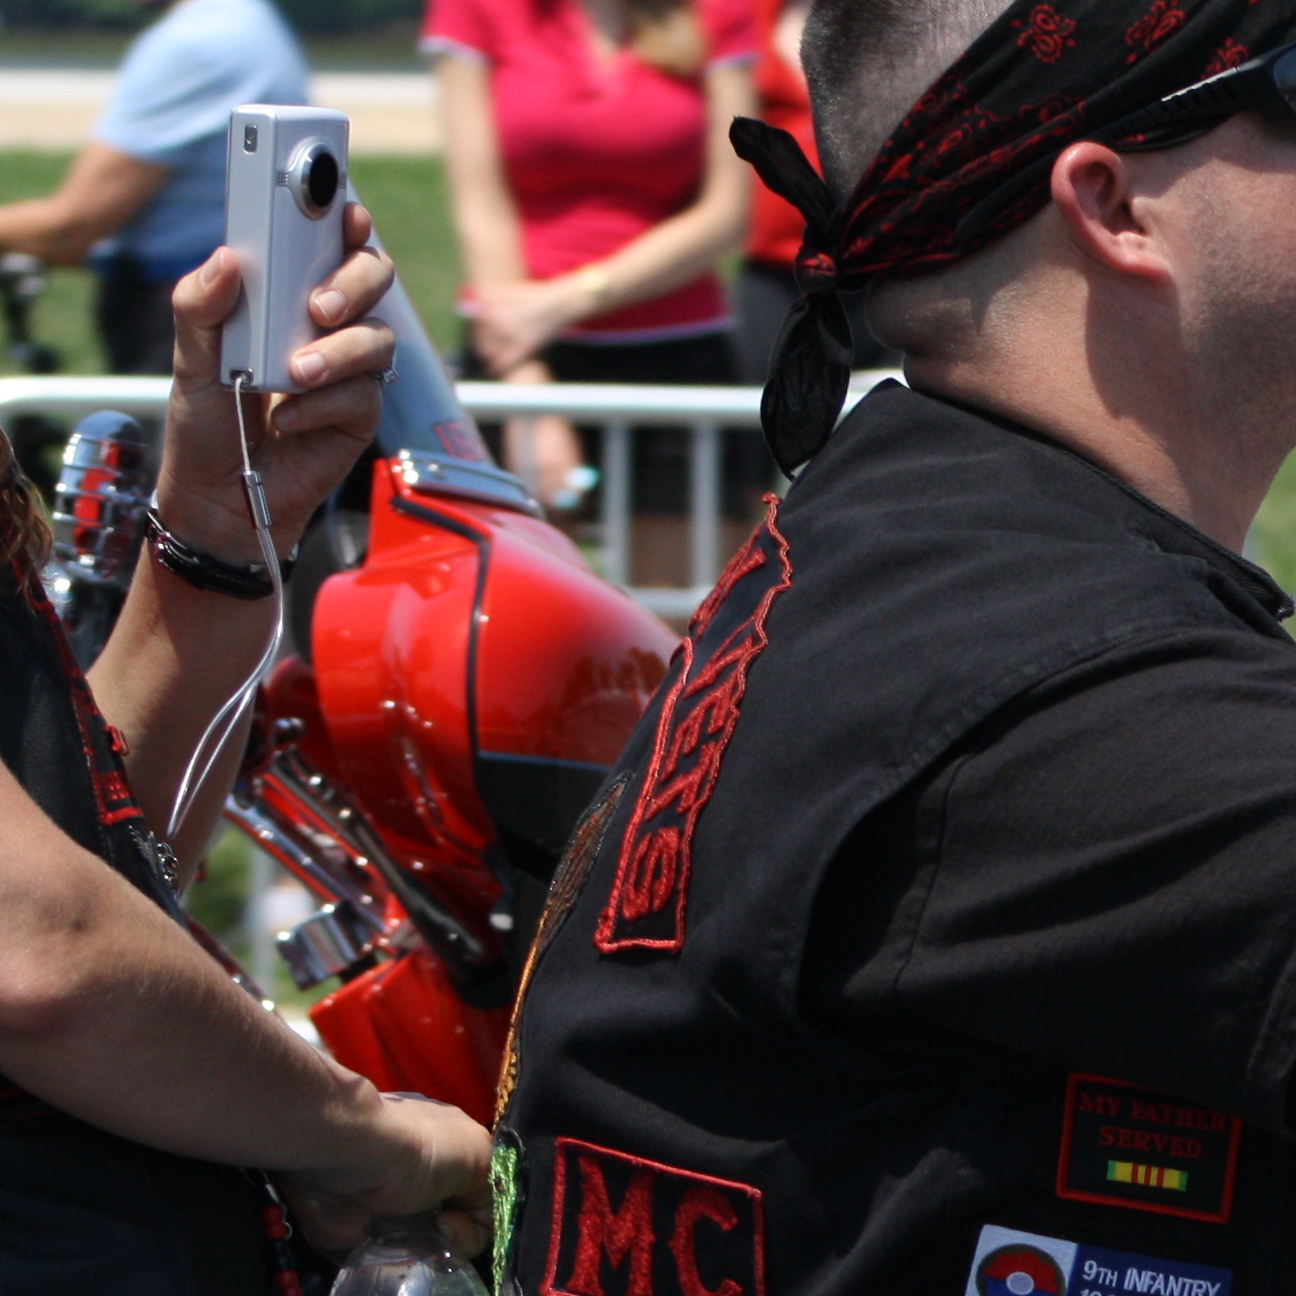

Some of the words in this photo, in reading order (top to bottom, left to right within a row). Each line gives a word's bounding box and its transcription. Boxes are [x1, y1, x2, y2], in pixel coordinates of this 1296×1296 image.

[1079, 1092, 1122, 1116] MY
[1130, 1100, 1227, 1132] FATHER
[1098, 1125, 1203, 1159] SERVED
